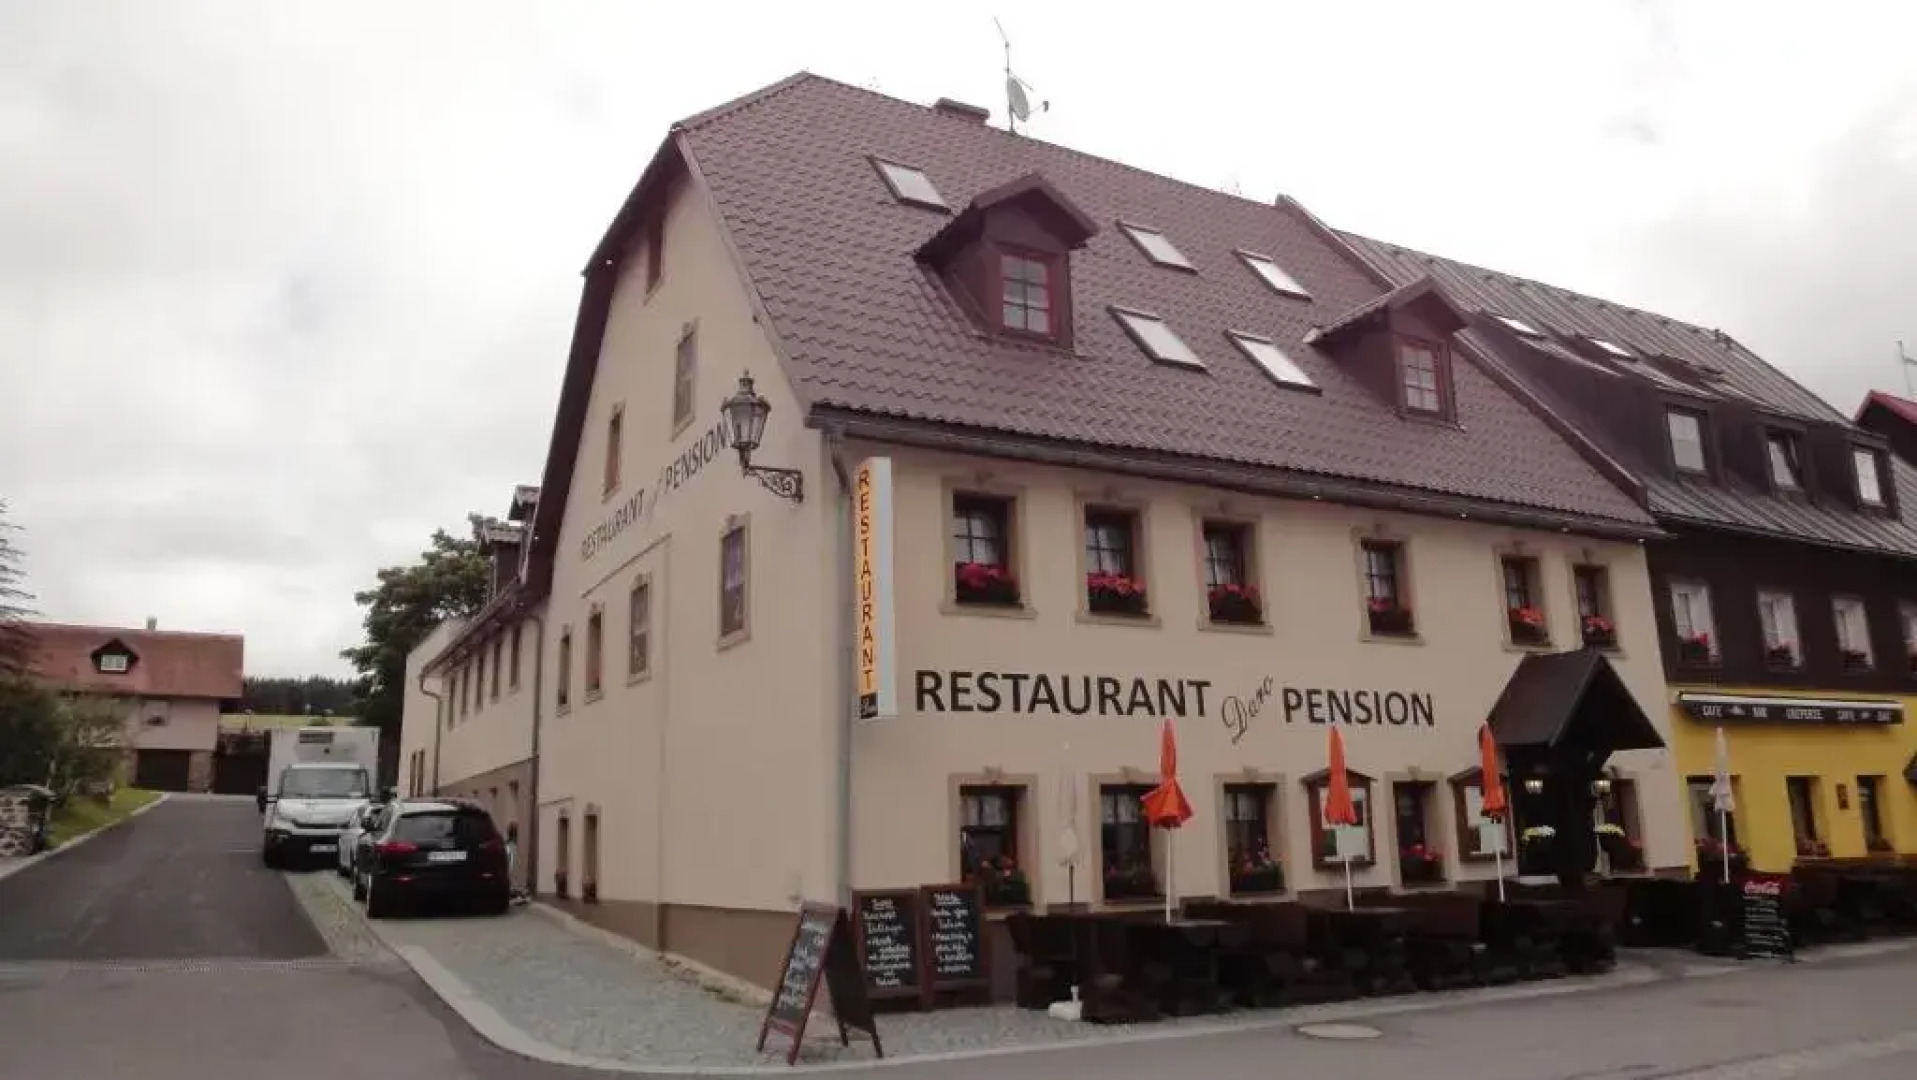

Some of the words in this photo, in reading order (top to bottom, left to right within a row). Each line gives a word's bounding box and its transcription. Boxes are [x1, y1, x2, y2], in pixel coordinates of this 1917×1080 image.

[664, 417, 728, 494] PENSION
[858, 469, 874, 690] RESTAURANT
[915, 670, 1211, 718] RESTAURANT
[1282, 687, 1436, 727] PENSION
